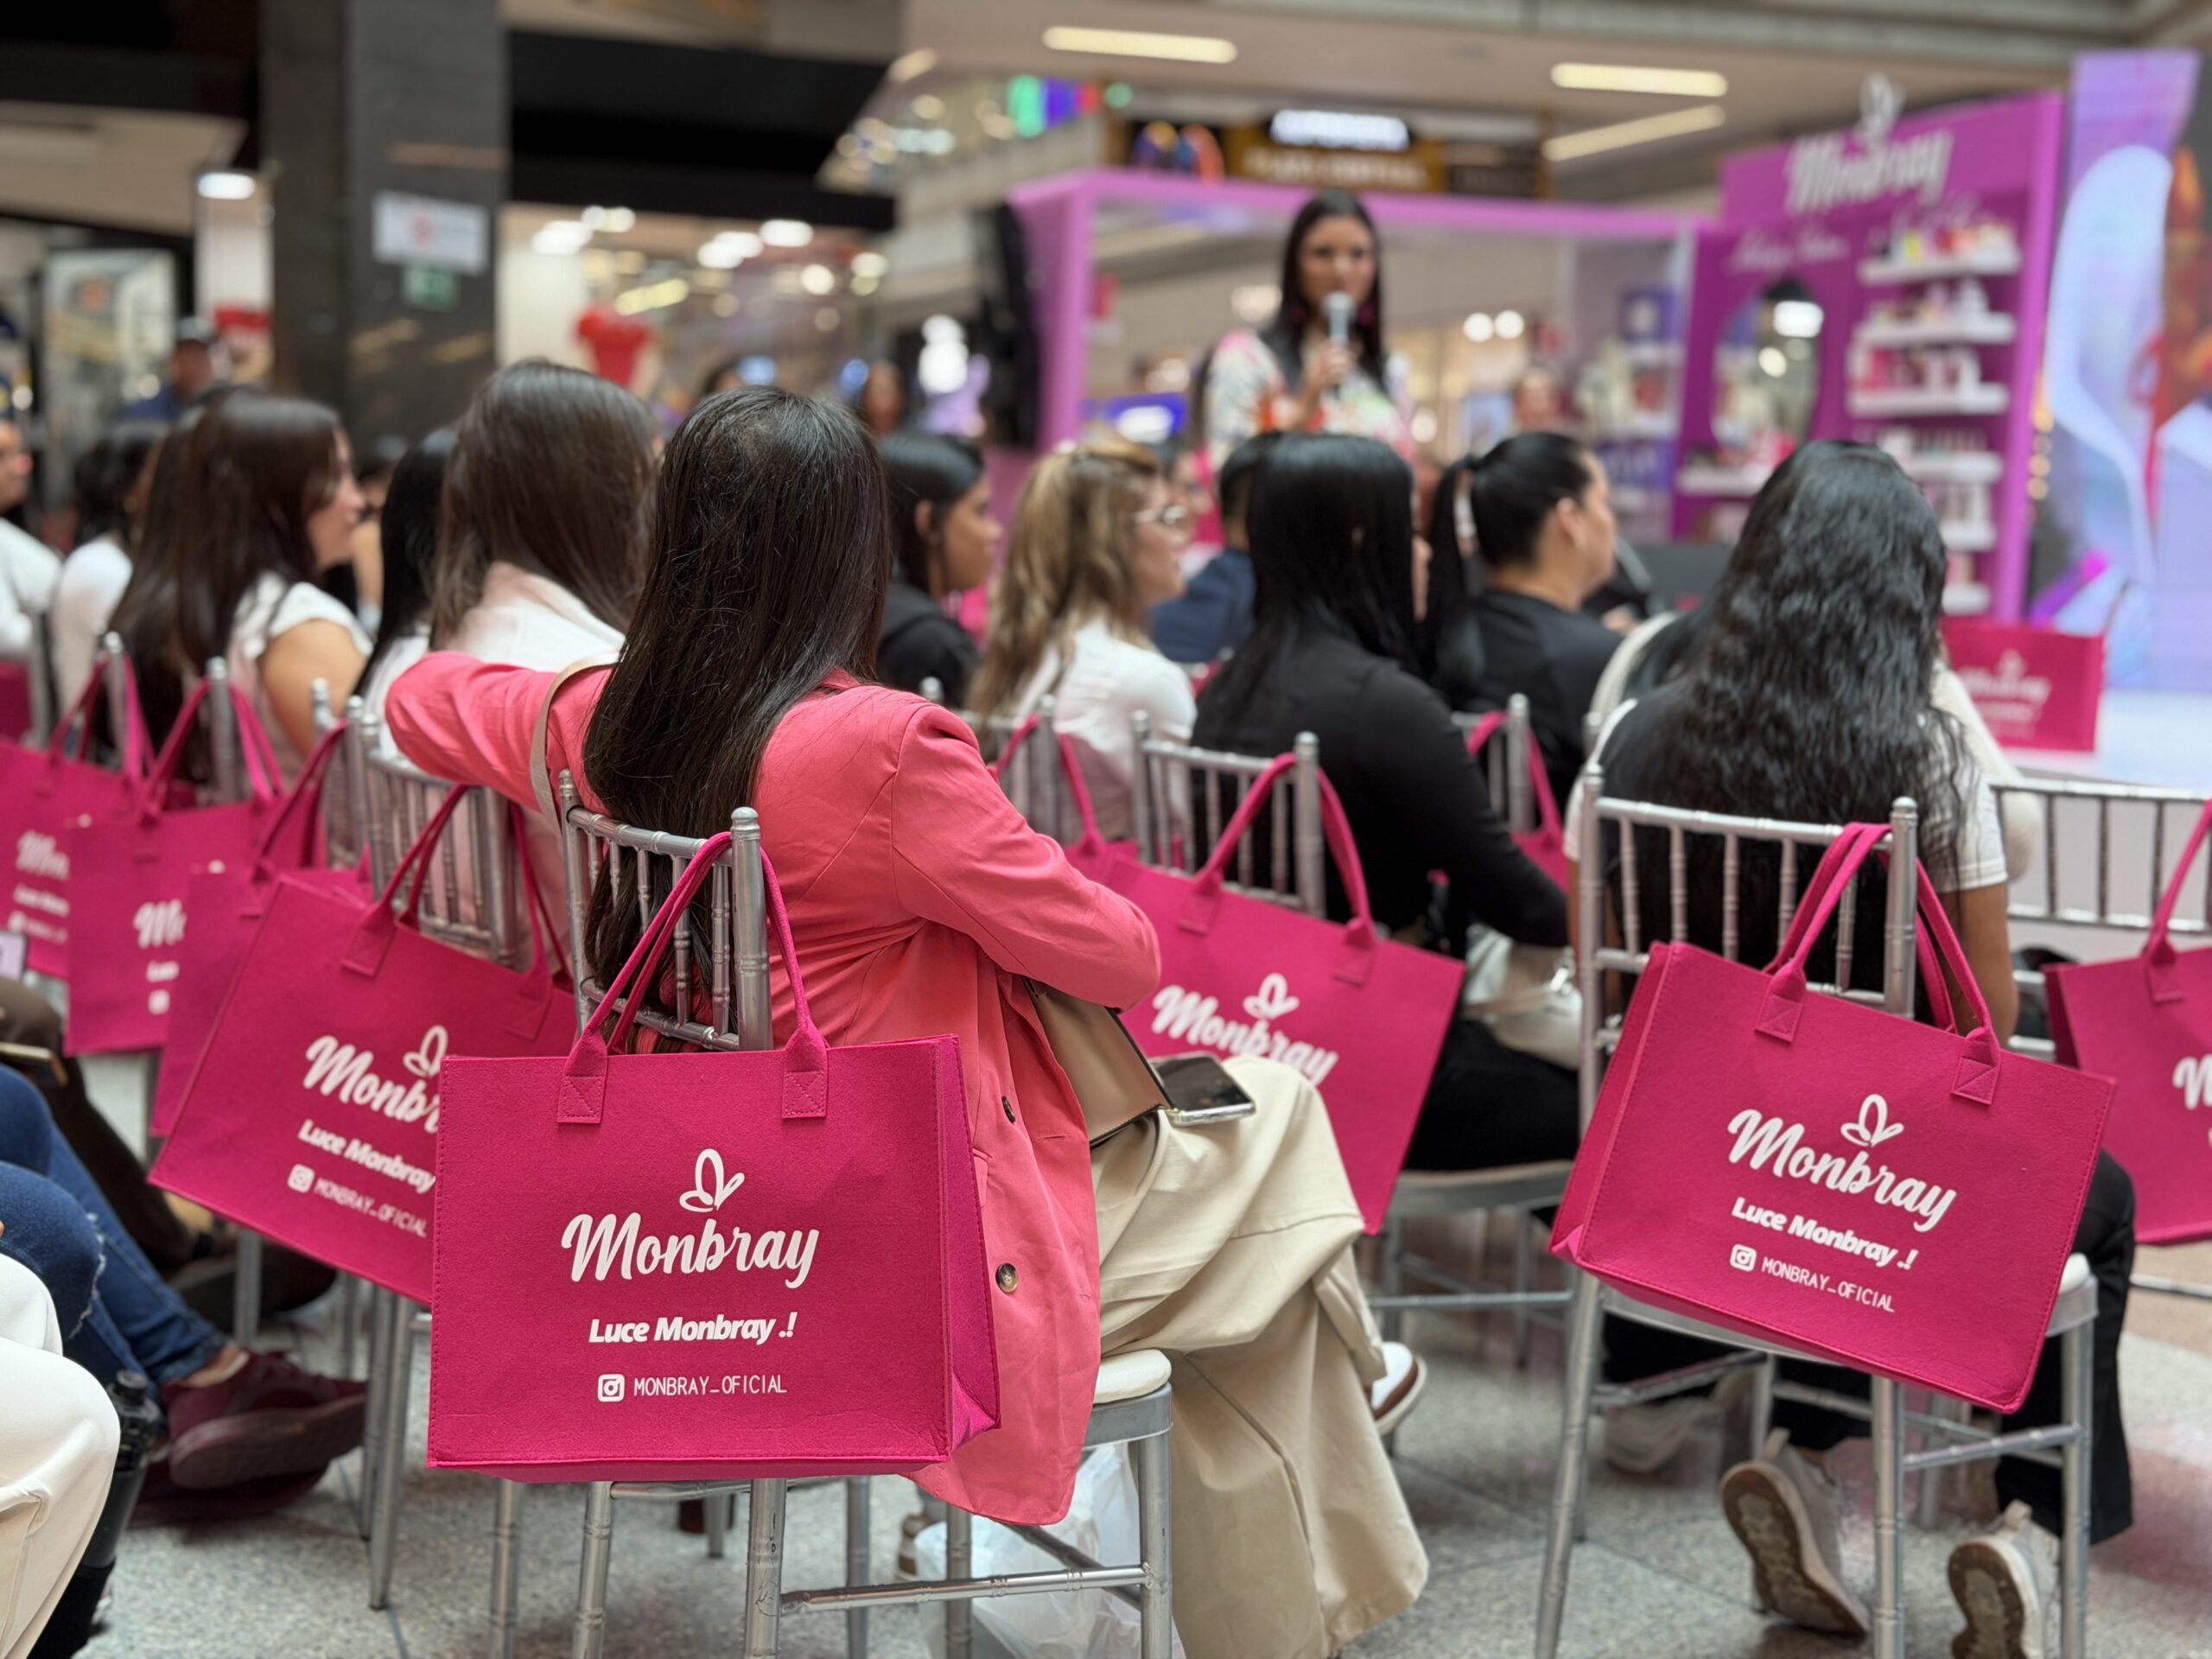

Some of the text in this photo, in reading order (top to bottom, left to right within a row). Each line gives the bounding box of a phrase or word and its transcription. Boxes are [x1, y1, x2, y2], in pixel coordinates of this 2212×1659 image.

[1151, 984, 1338, 1087] Monbray
[298, 1119, 436, 1194] Luce Monbray
[1727, 1109, 1957, 1232] Monbray
[314, 1177, 428, 1238] MONBRAY_OFICIAL
[1732, 1197, 1787, 1230] Luce
[1788, 1215, 1898, 1268] Monbray
[562, 1212, 820, 1288] Monbray
[1761, 1255, 1896, 1313] MONBRAY_OFICIAL
[588, 1319, 650, 1343] Luce
[653, 1314, 777, 1345] Monbray
[633, 1375, 787, 1396] MONBRAY_OFICIAL
